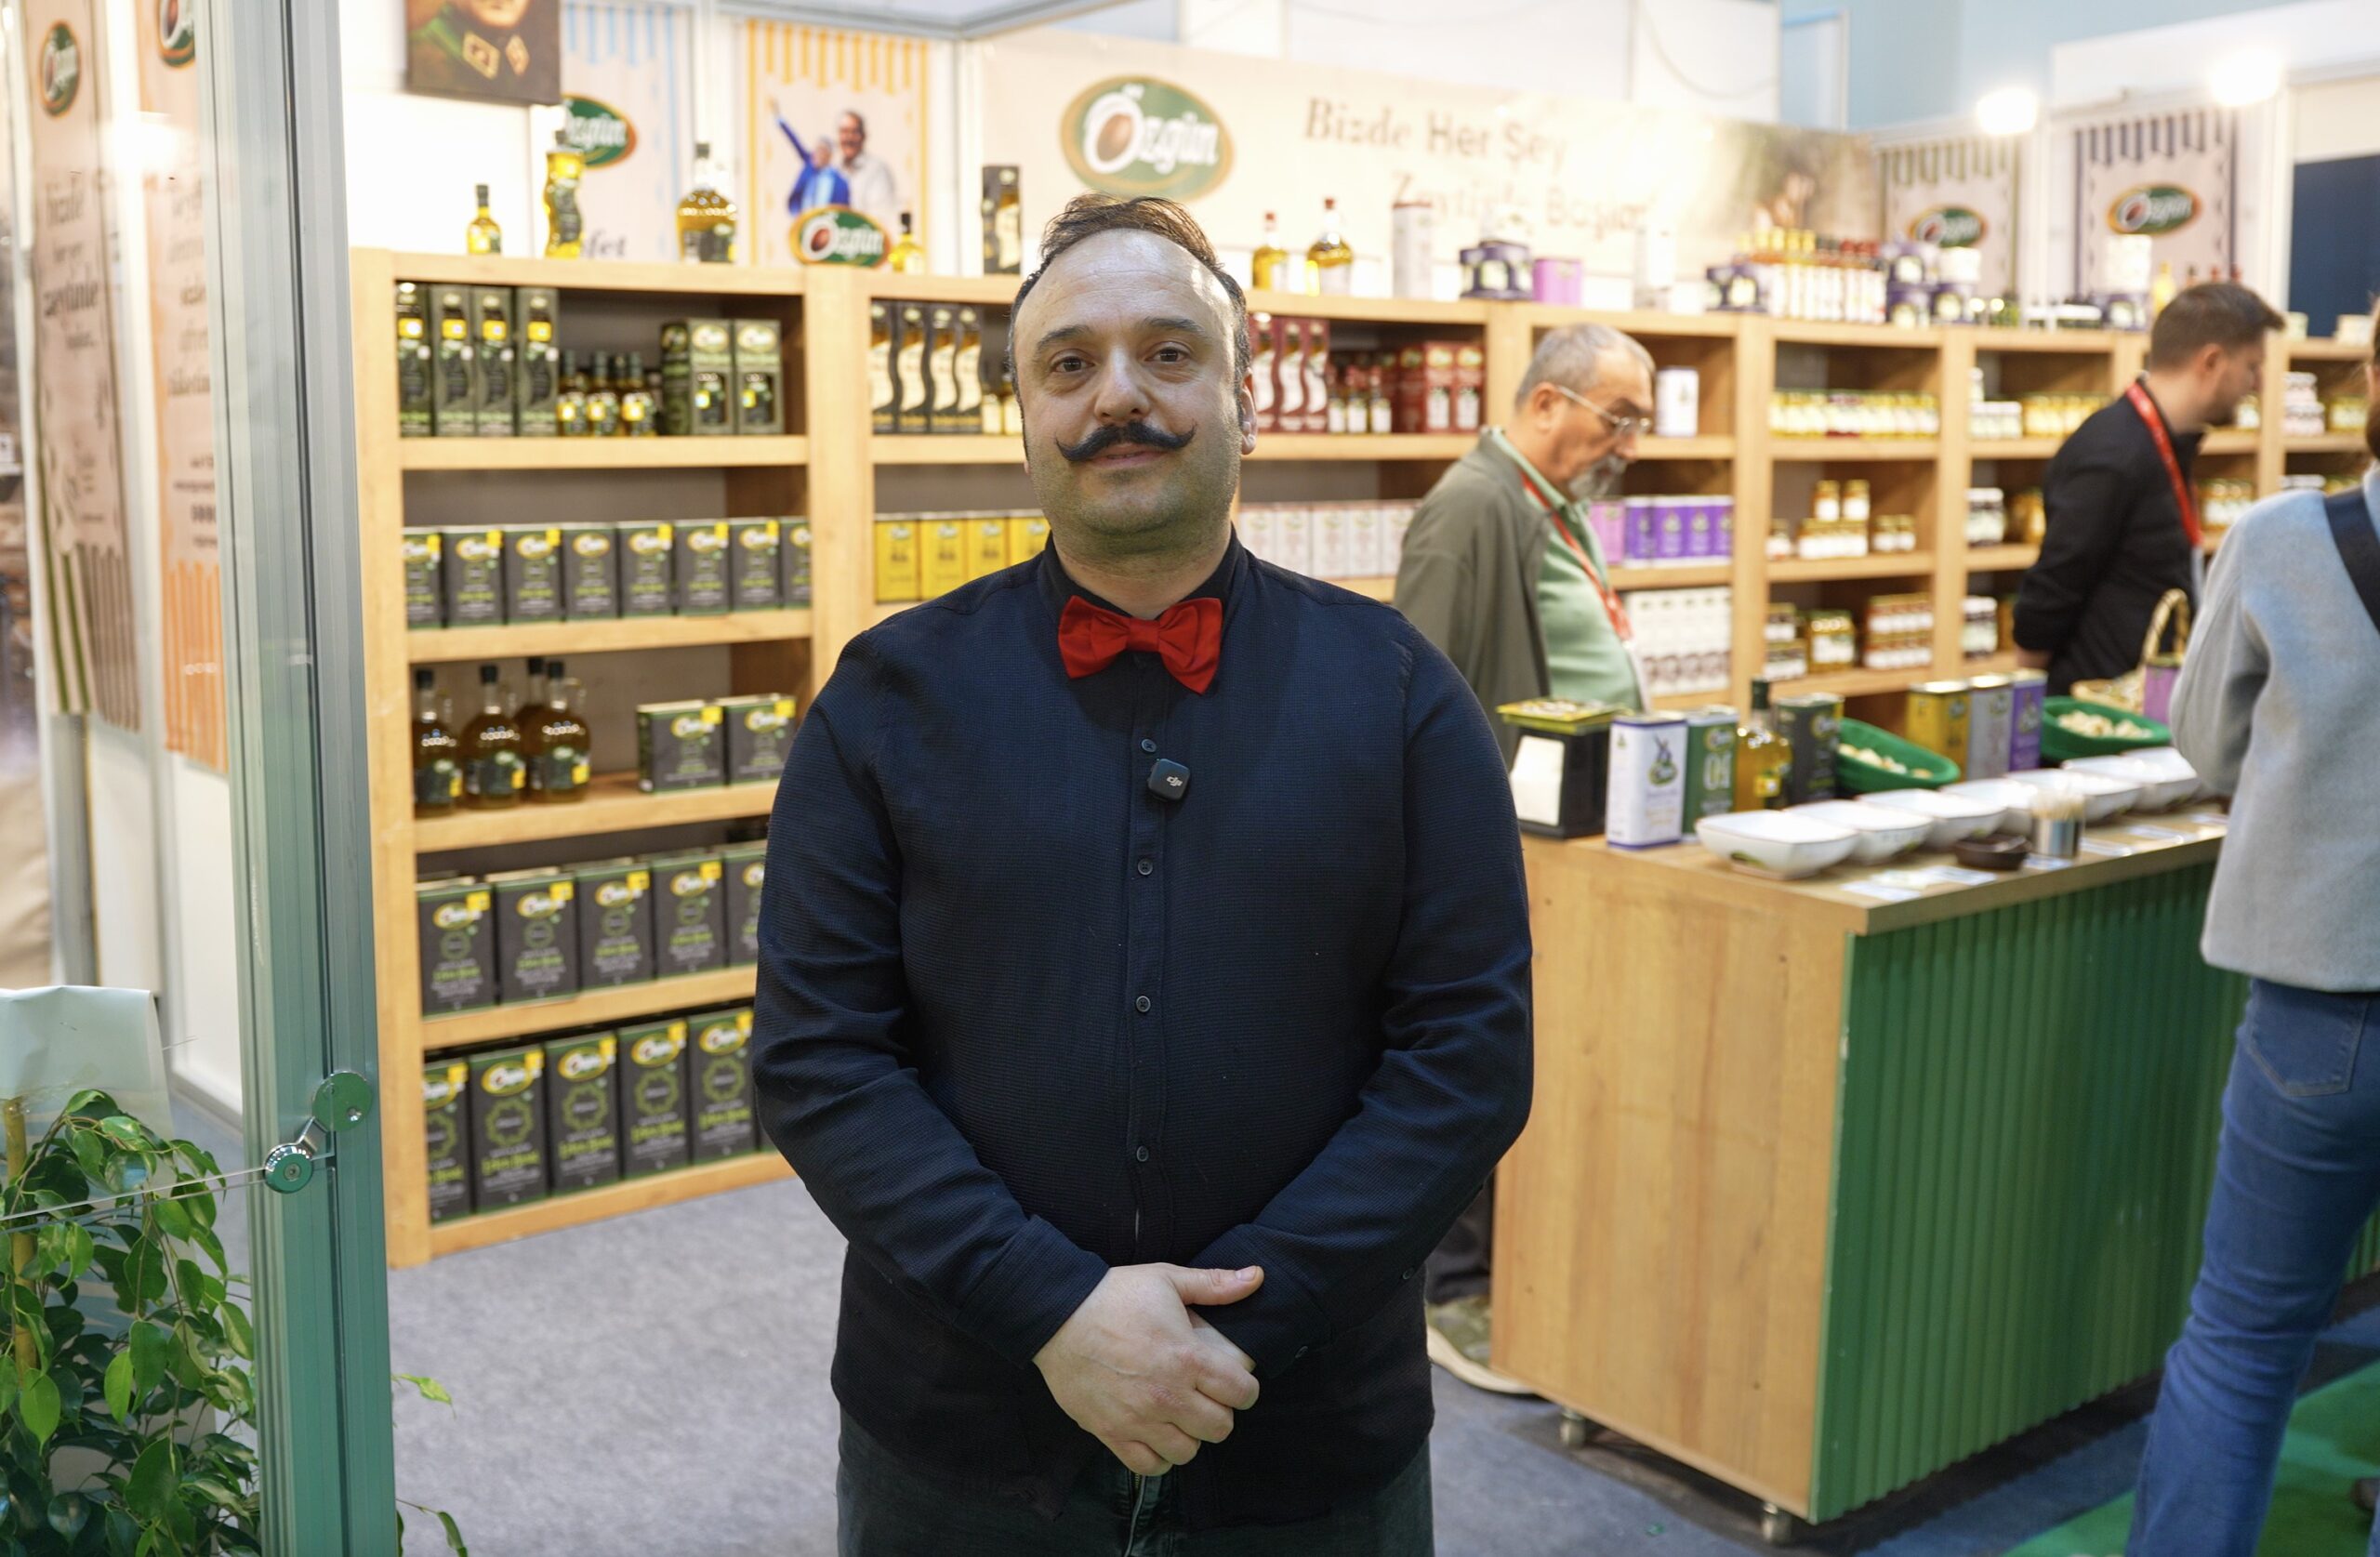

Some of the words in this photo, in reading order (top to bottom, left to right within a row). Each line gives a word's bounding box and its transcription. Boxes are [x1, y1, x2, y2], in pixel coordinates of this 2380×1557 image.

[563, 98, 628, 152] zgün
[1304, 96, 1411, 149] Bizde
[1426, 109, 1491, 158] Her
